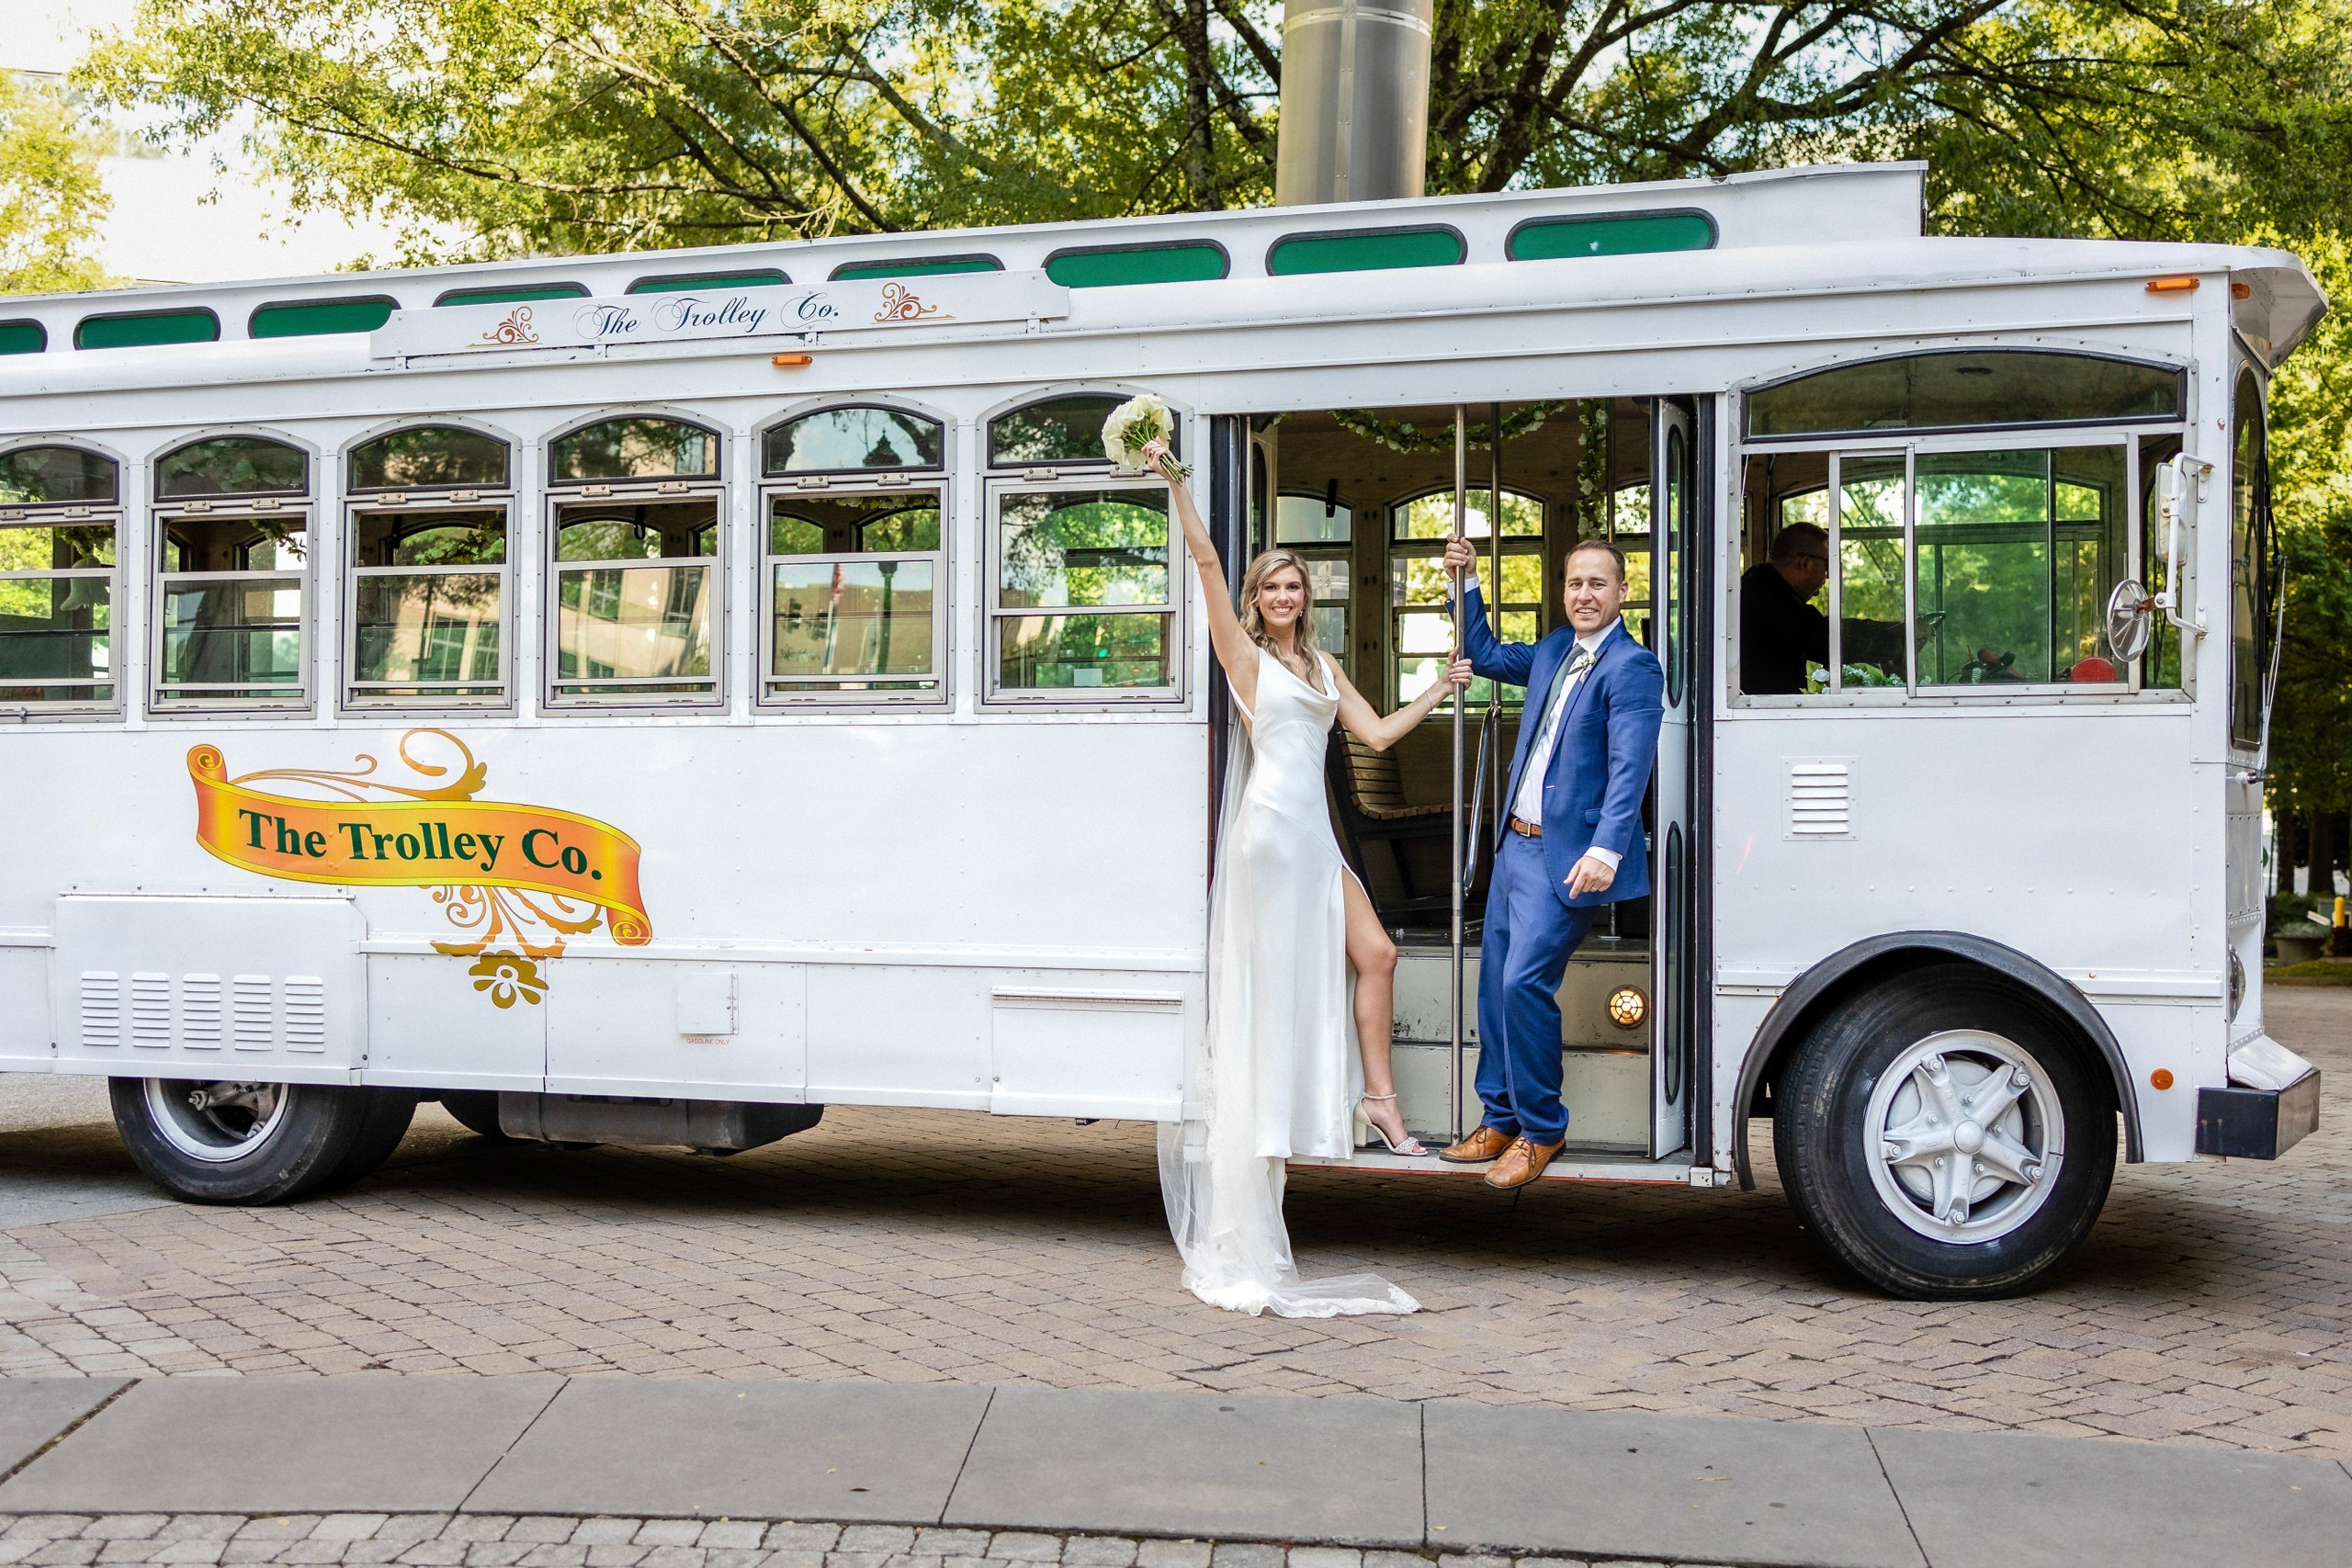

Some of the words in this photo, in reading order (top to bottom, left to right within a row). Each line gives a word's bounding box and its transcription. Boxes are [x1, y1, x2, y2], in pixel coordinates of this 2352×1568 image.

[571, 304, 641, 339] The
[651, 296, 772, 333] Trolley
[781, 292, 840, 329] Co.
[238, 808, 327, 858] The
[338, 822, 504, 872] Trolley
[522, 829, 603, 881] Co.
